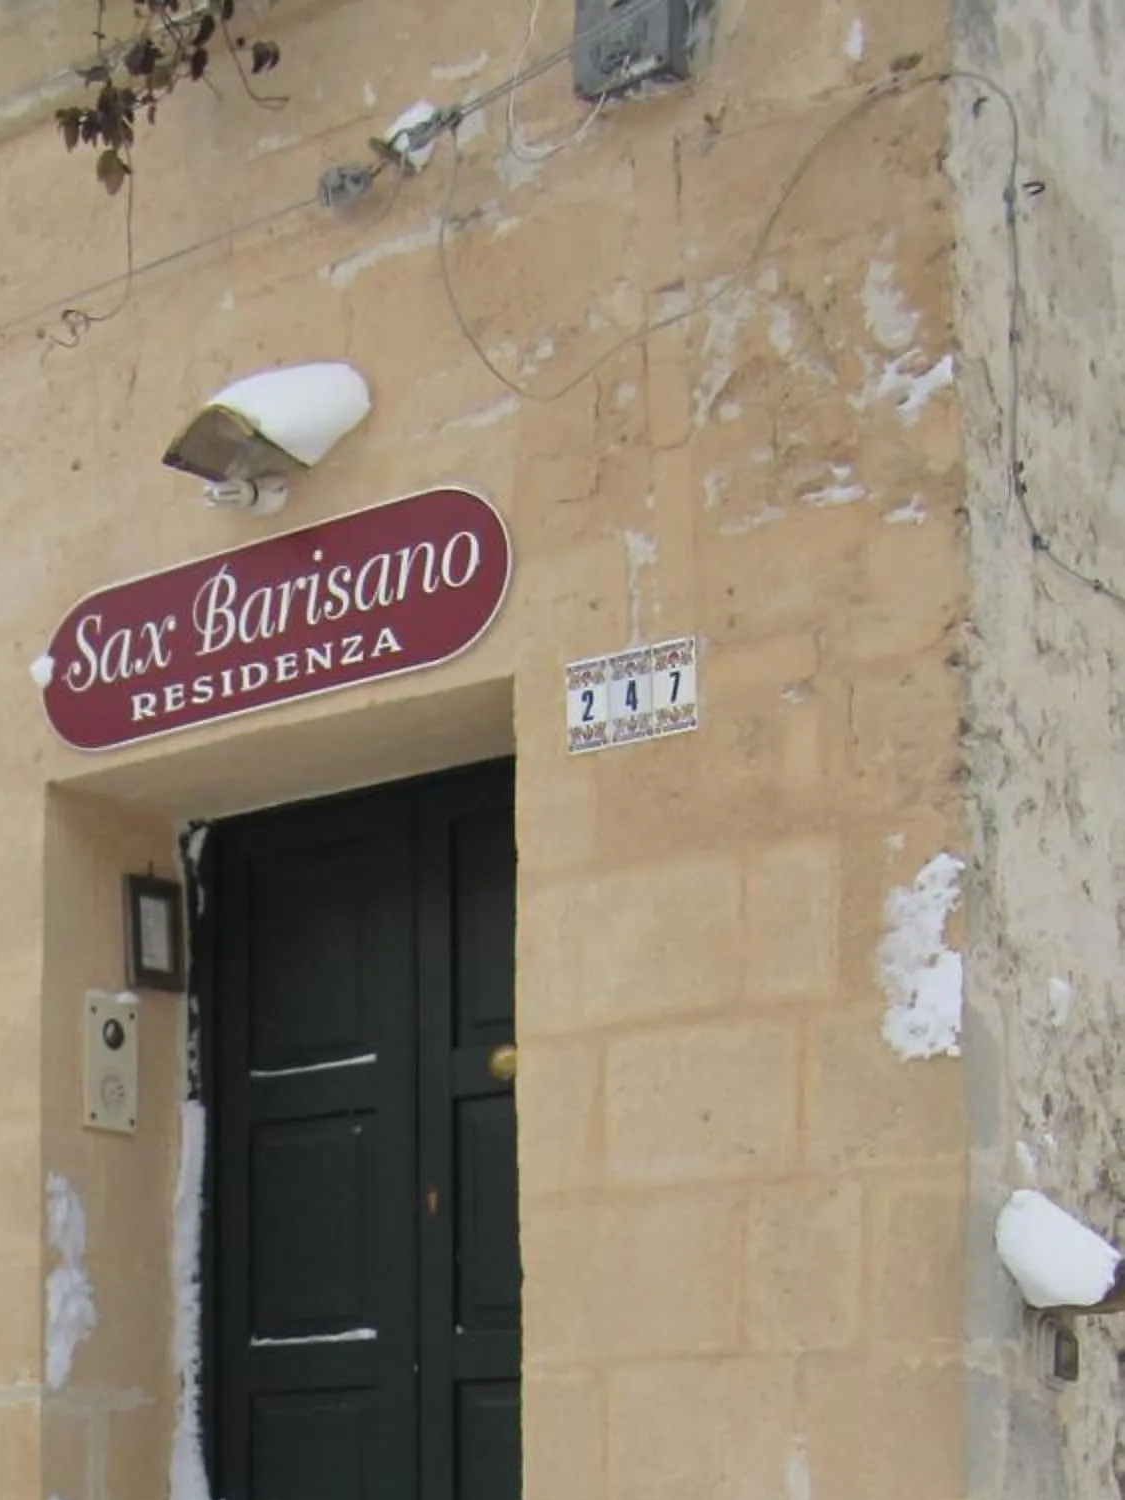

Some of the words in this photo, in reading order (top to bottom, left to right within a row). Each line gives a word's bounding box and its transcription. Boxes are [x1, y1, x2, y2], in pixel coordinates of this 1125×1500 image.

[63, 613, 176, 692] Sax
[192, 531, 480, 657] Barisano
[130, 627, 403, 722] RESIDENZA
